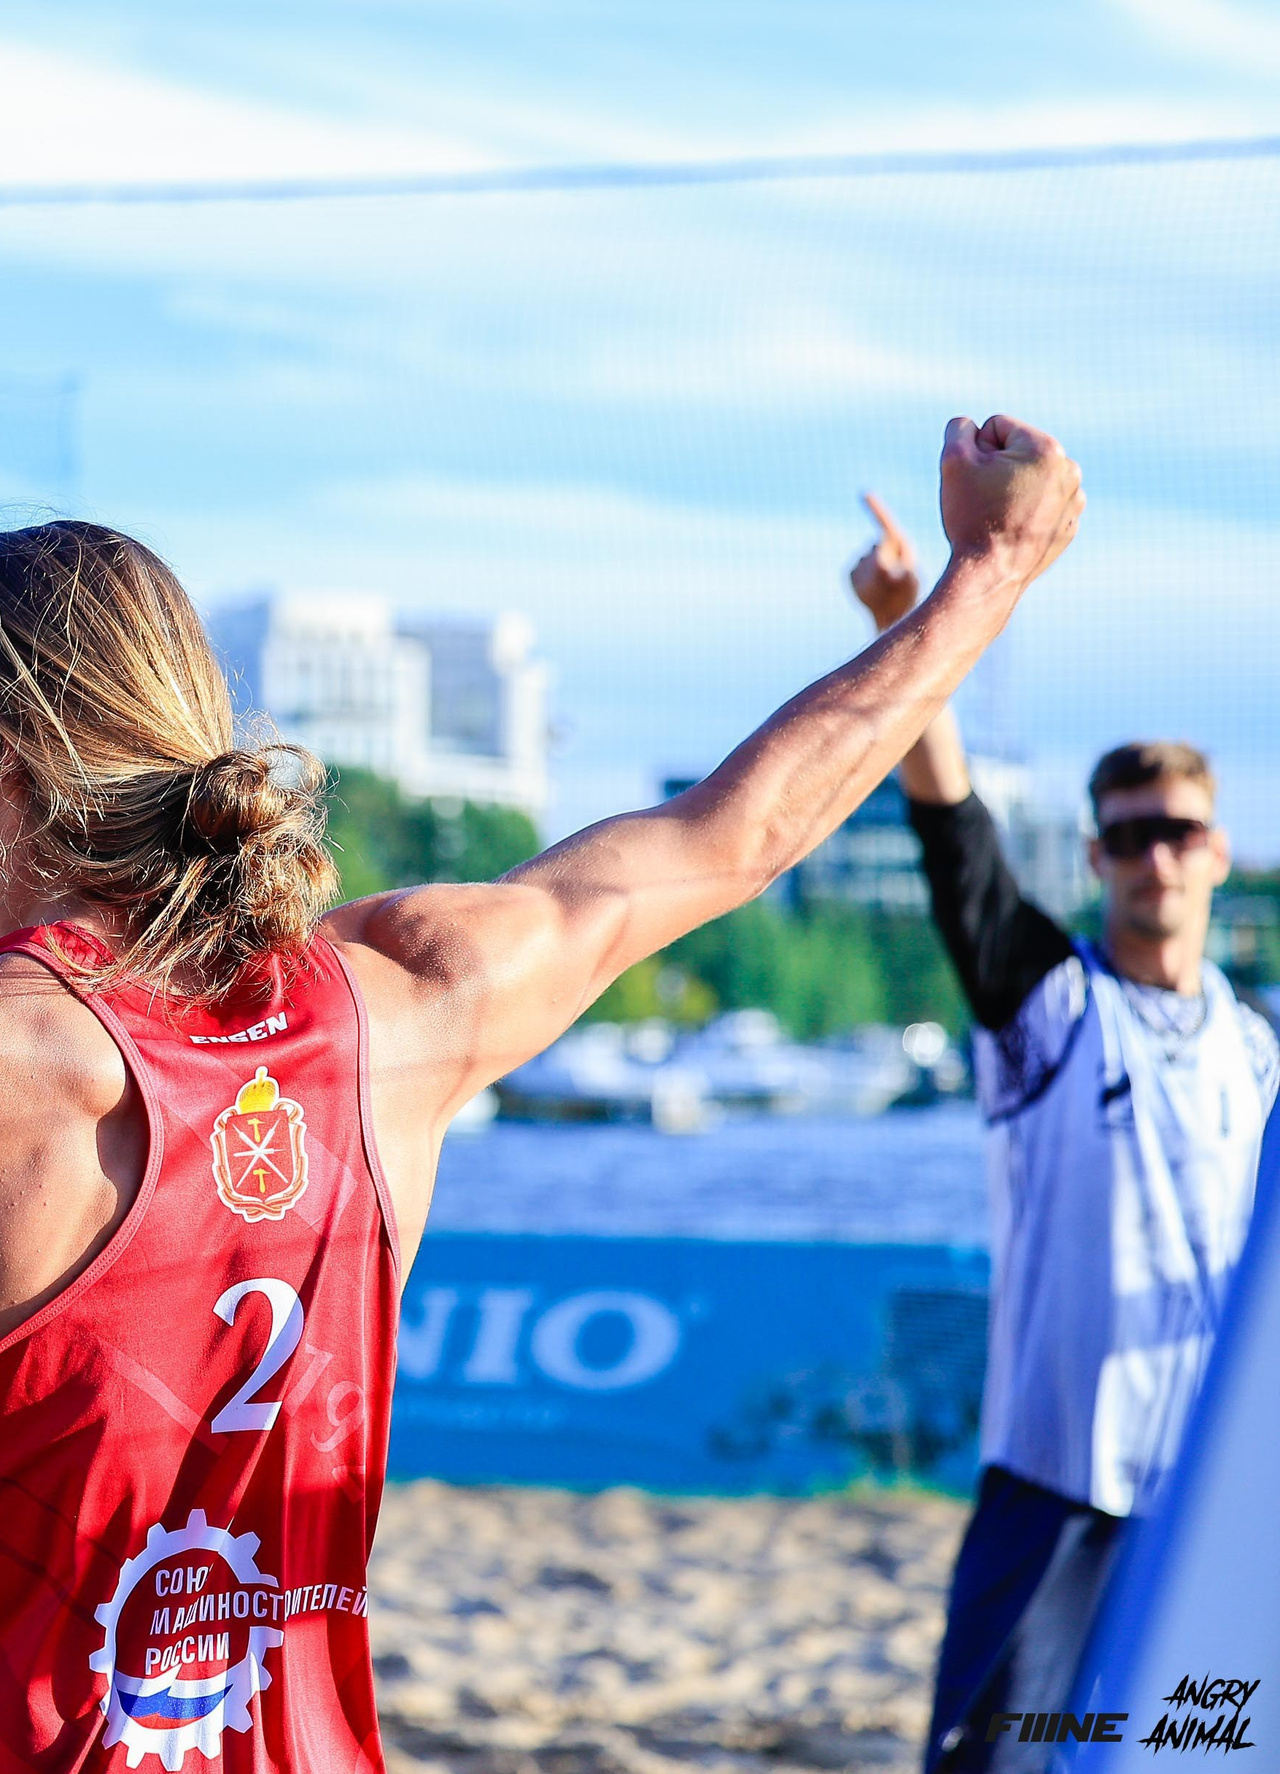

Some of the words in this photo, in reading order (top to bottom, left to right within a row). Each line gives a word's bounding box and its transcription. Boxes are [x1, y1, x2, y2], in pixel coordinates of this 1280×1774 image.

[189, 1011, 288, 1044] ENSEN
[211, 1278, 304, 1433] 2
[155, 1563, 214, 1597] СОЮ
[145, 1631, 230, 1676] РОССИИ
